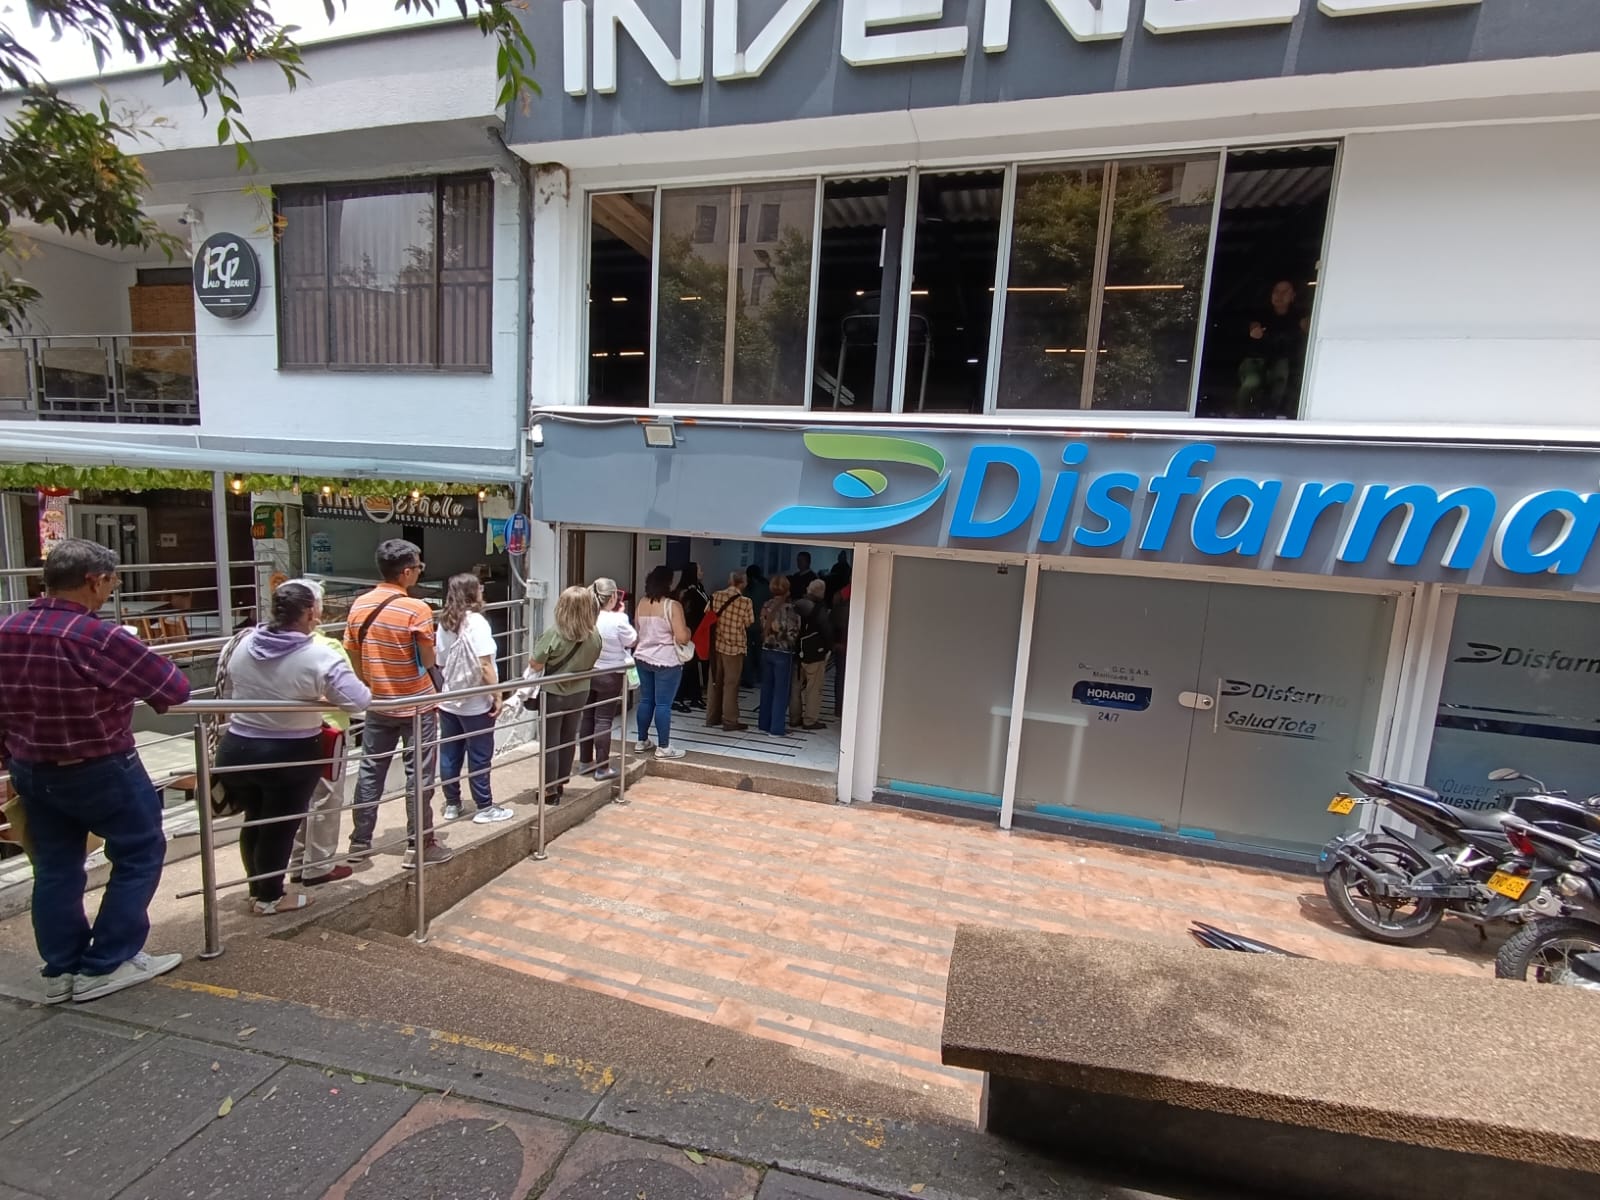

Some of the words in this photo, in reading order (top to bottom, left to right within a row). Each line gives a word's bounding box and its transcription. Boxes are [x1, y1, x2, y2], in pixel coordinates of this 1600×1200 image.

[317, 507, 363, 517] CAFETERIA
[948, 442, 1600, 575] Disfarma
[395, 514, 459, 526] RESTAURANTE
[1086, 688, 1137, 702] HORARIO
[1097, 711, 1121, 723] 24/7
